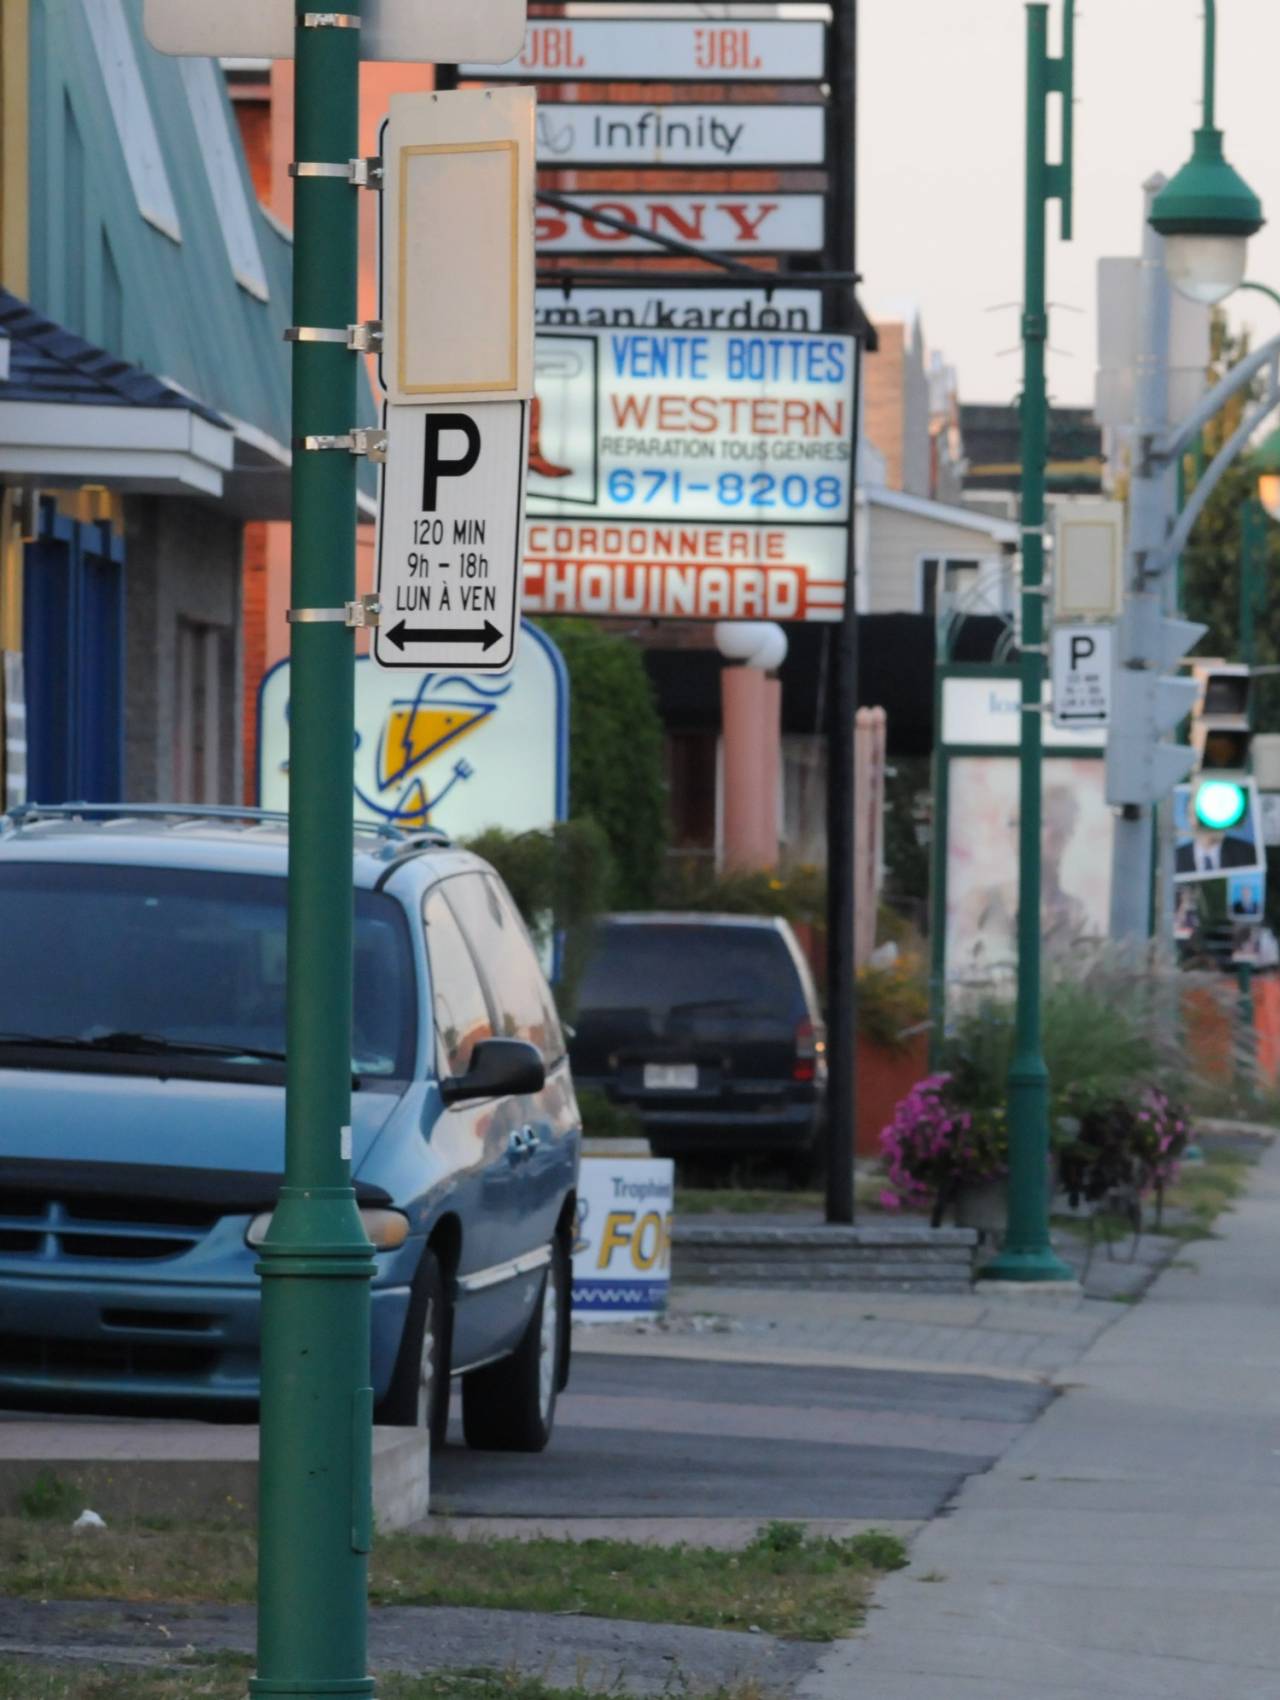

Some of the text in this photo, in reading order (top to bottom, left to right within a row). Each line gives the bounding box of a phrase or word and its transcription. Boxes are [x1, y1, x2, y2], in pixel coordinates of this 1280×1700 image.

[520, 27, 762, 70] JBL JBL
[594, 112, 744, 154] Infinity
[535, 203, 779, 241] SONY
[535, 297, 809, 330] man/kardon
[612, 336, 844, 384] VENTE BOTTES
[610, 395, 844, 436] WESTERN
[421, 413, 481, 512] P
[601, 436, 849, 461] REPARATION TOUS GENRES
[607, 469, 841, 508] 671-8208
[413, 519, 486, 545] 120 MIN
[529, 527, 785, 559] CORDONNERIE
[407, 552, 428, 578] 9h
[460, 552, 488, 578] 18h
[396, 580, 496, 612] LUN À VEN
[1071, 635, 1095, 670] P
